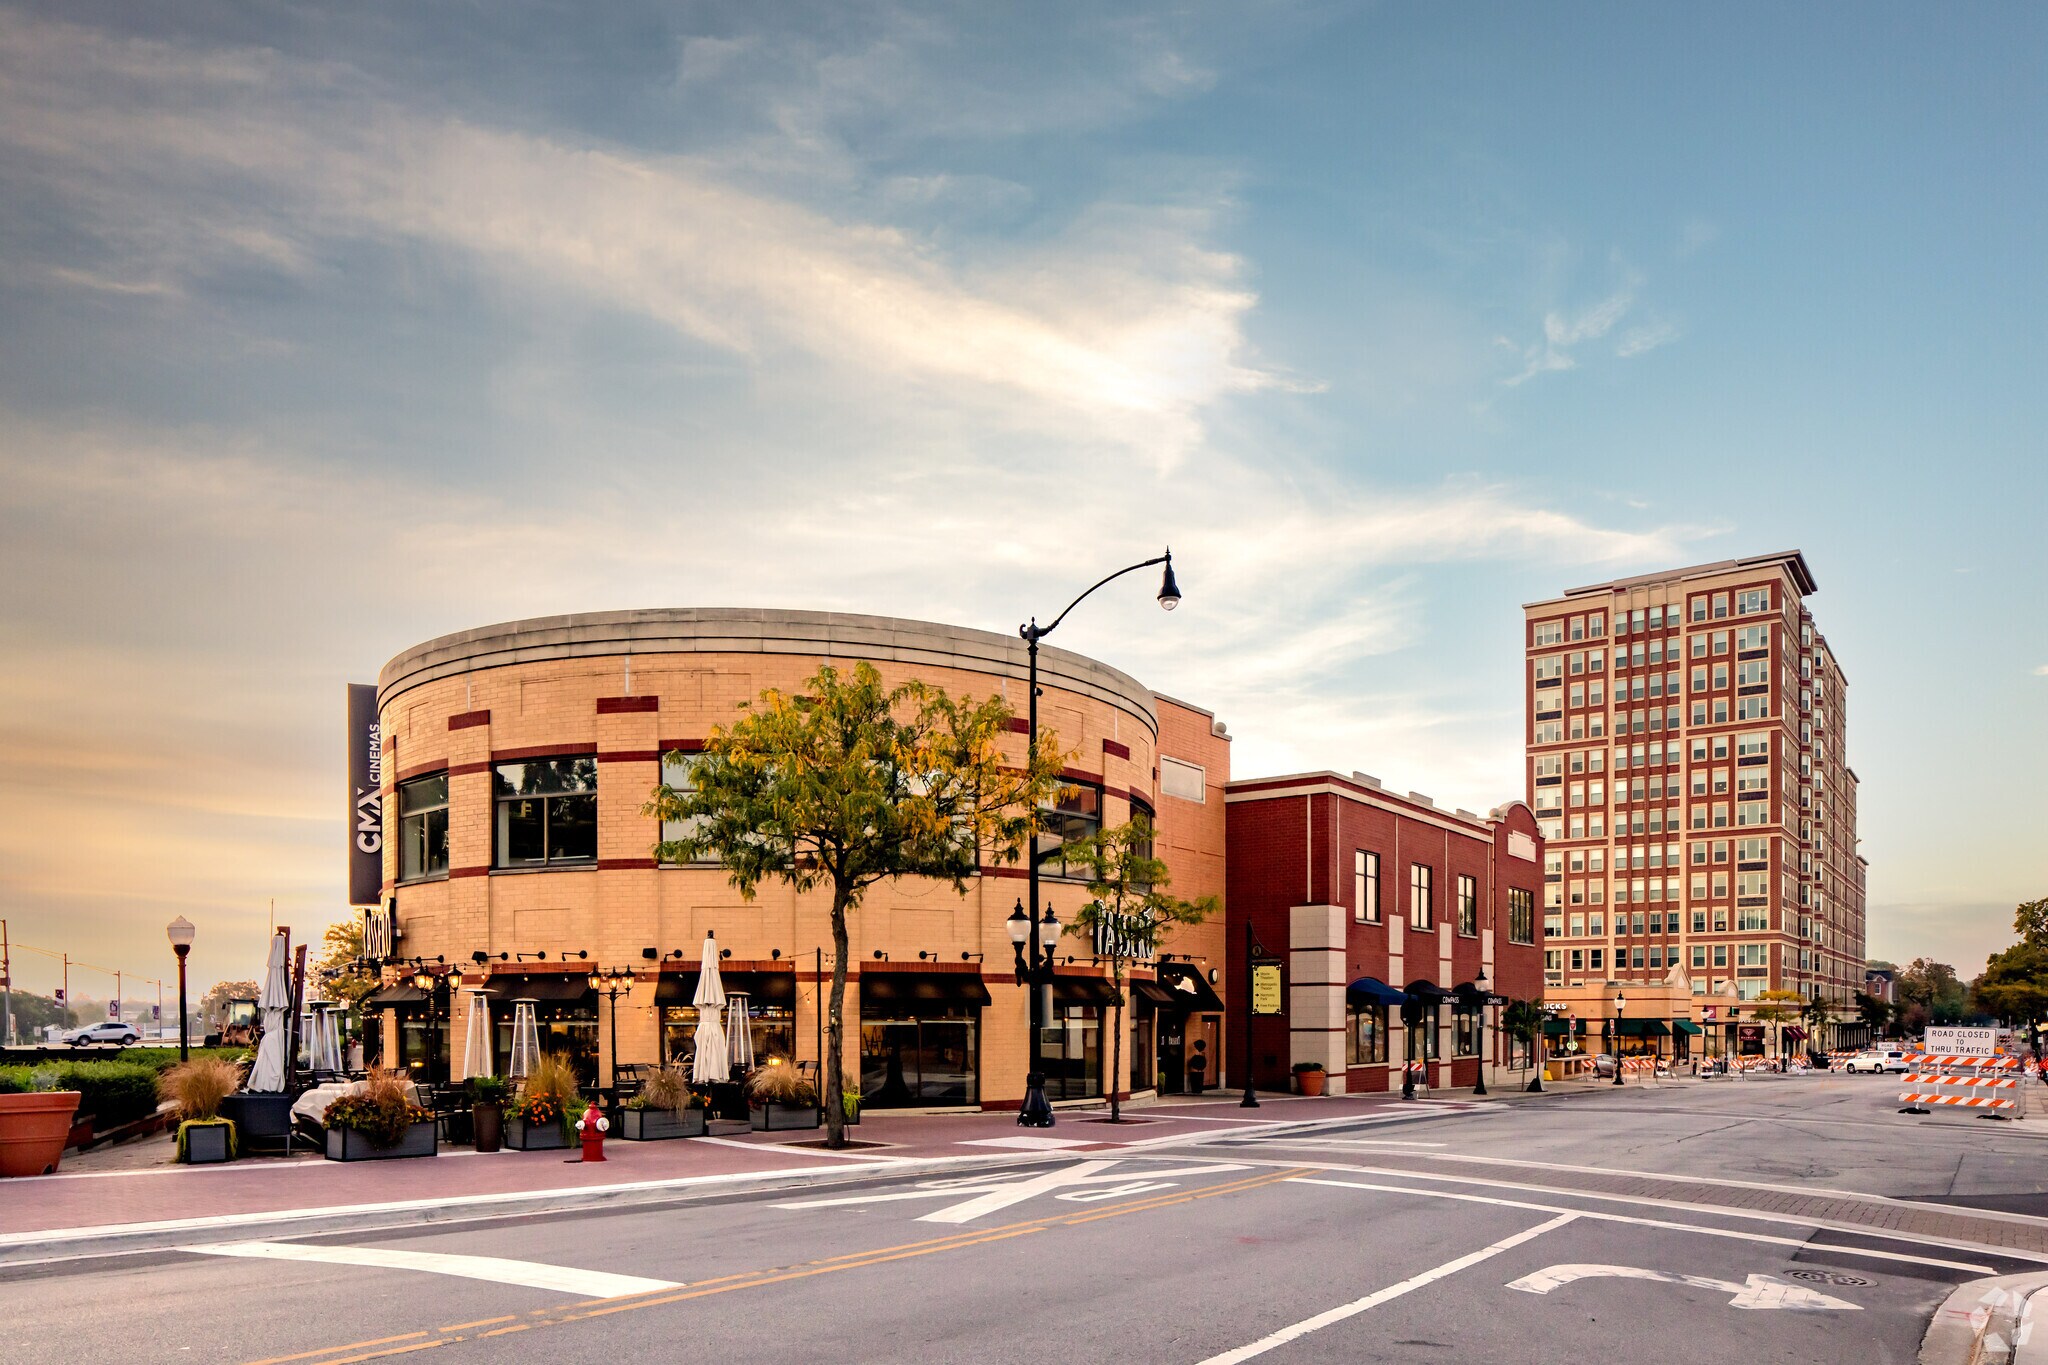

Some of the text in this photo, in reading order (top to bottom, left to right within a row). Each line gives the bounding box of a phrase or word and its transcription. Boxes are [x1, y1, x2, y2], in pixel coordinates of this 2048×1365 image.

[357, 722, 382, 854] CMX CINEMAS
[1442, 996, 1459, 1004] COMPASS
[1487, 997, 1502, 1005] COMPASS
[1931, 1030, 1990, 1039] ROAD CLOSED
[1930, 1045, 1990, 1055] THRU TRAFFIC
